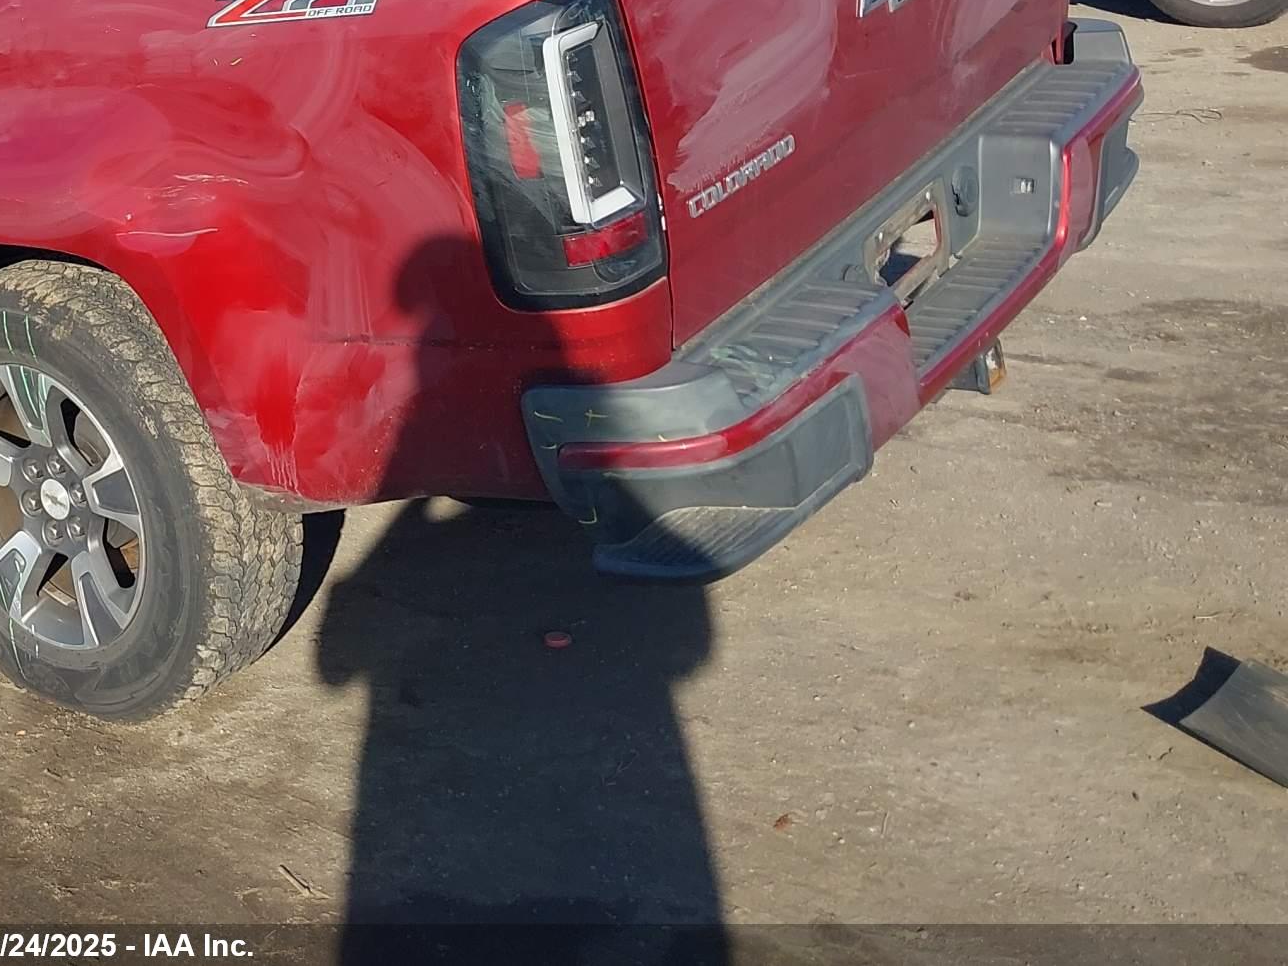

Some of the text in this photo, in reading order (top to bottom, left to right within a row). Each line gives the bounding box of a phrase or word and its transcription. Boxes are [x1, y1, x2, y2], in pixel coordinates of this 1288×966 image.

[307, 4, 372, 18] OFF ROAD
[688, 134, 796, 219] COLORADO
